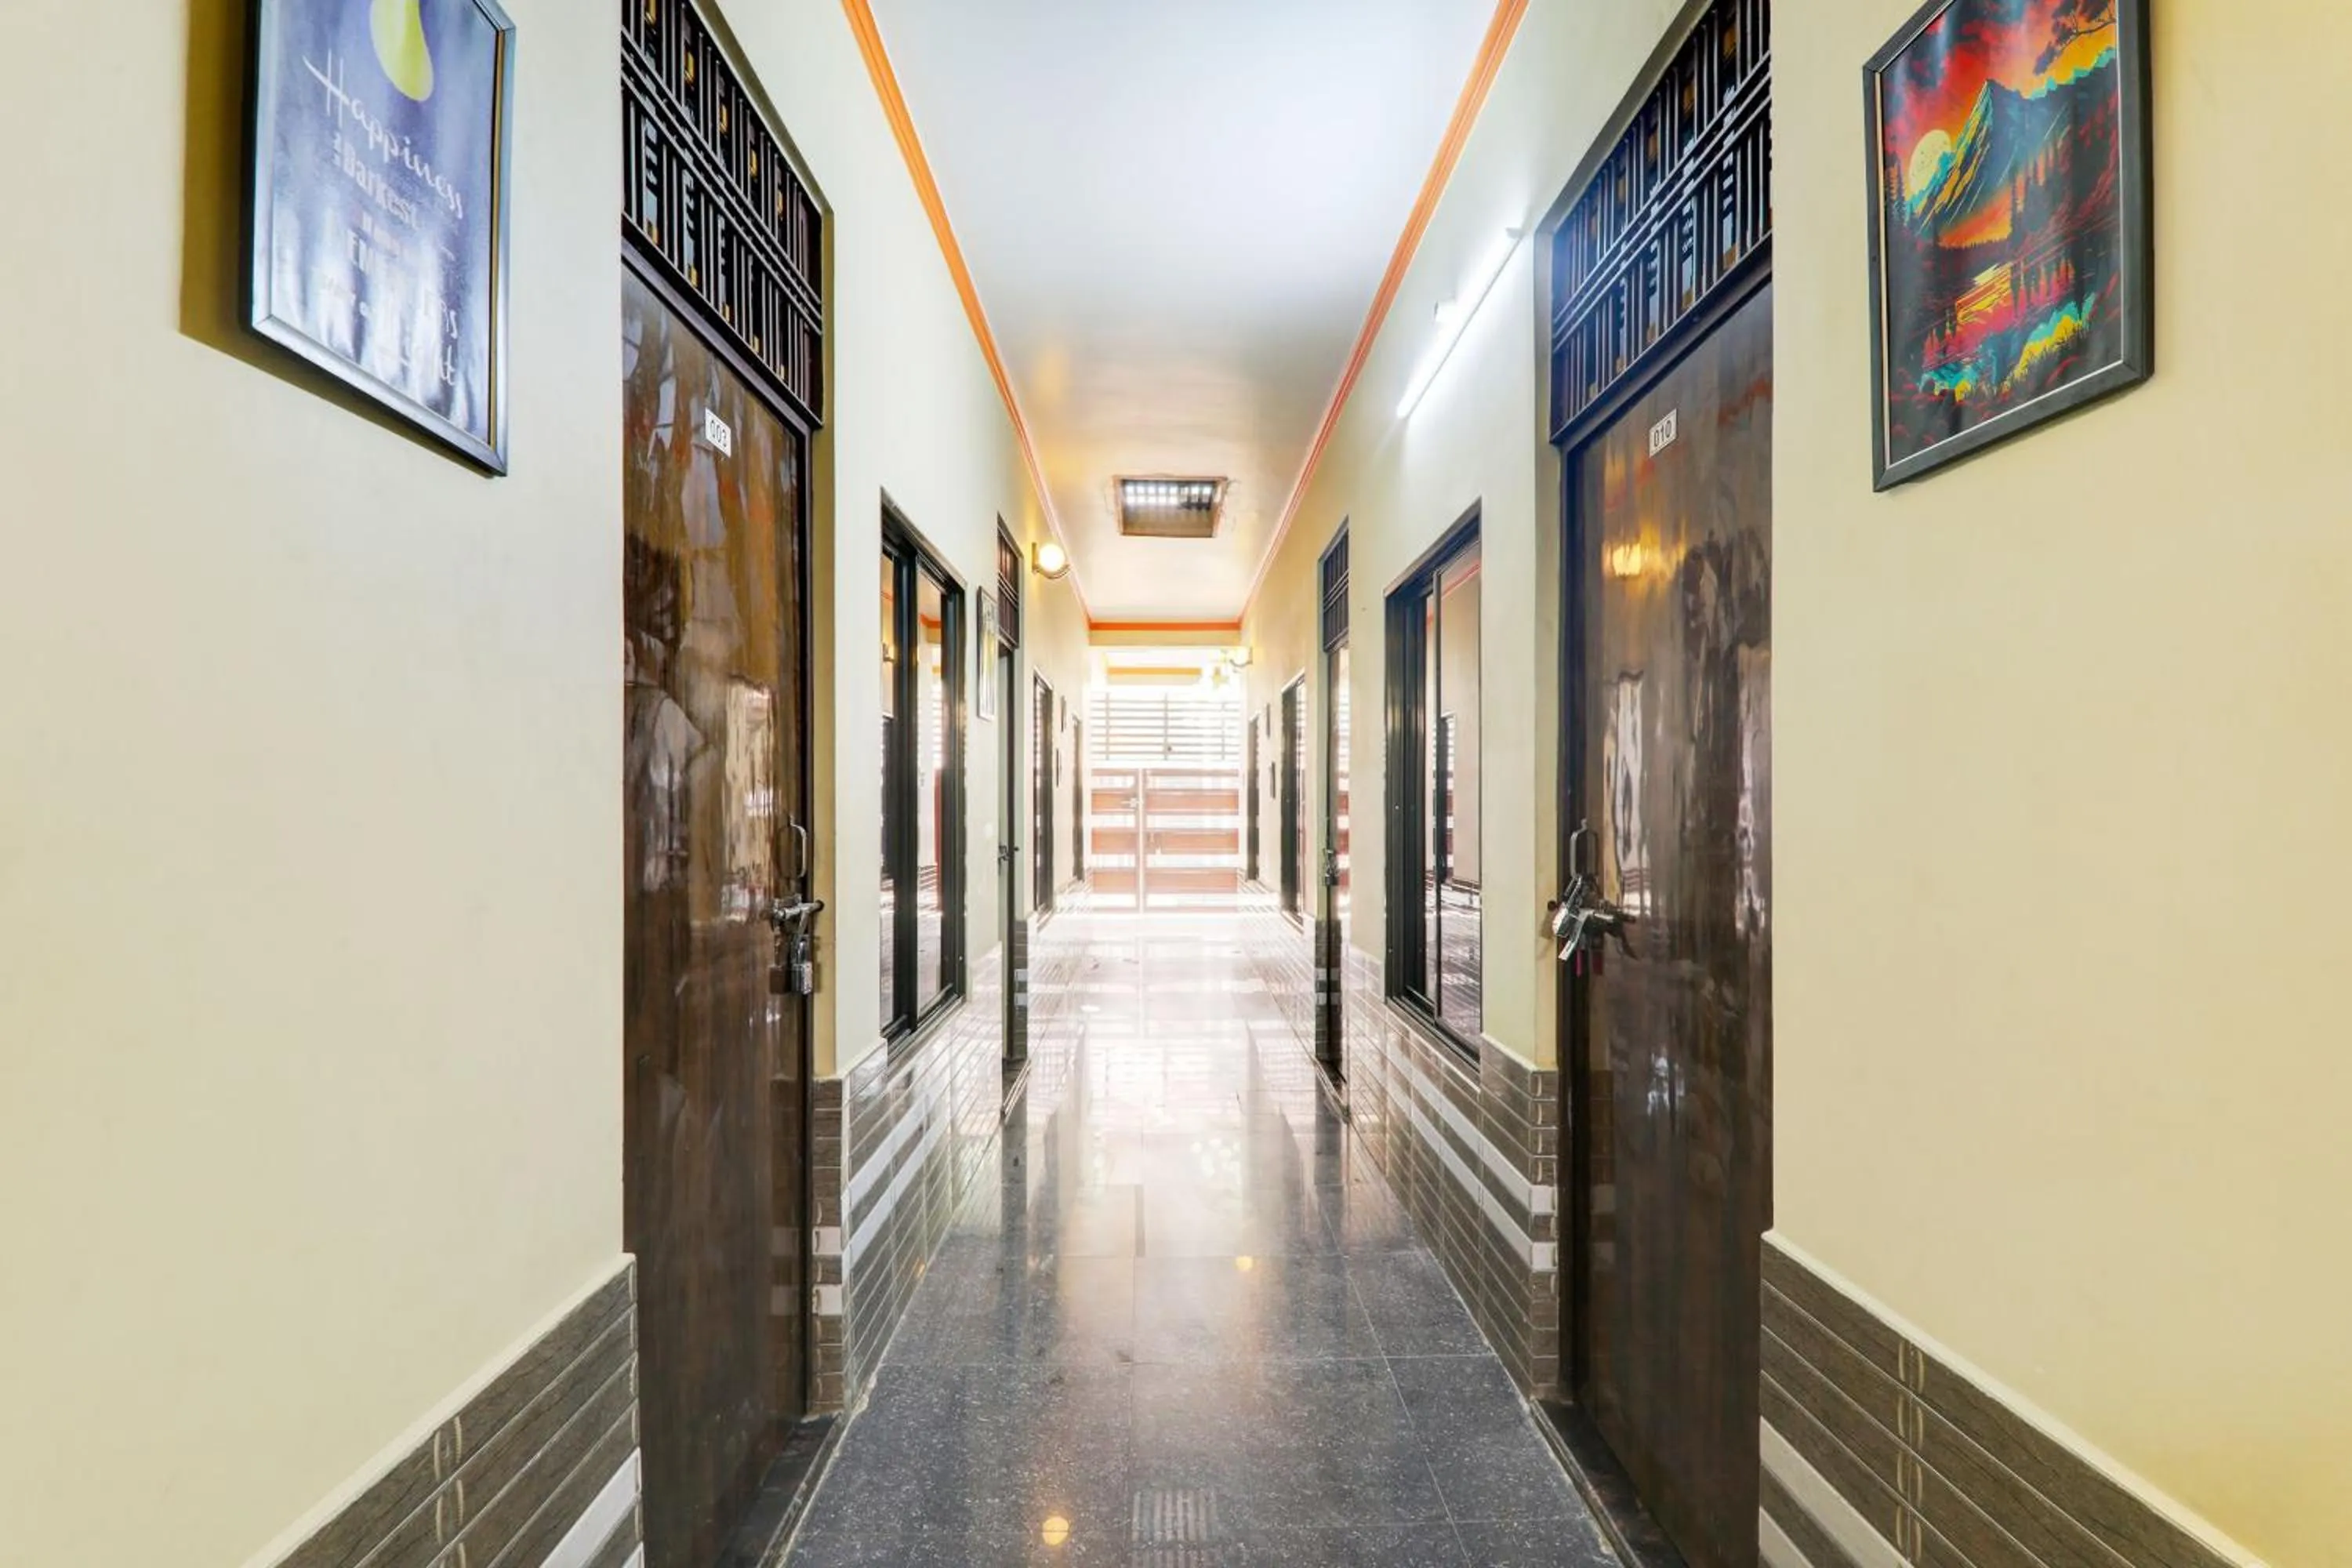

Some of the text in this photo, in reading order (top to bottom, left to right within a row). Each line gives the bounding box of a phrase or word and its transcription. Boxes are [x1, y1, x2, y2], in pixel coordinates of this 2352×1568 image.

[303, 49, 463, 219] Happiness
[343, 141, 421, 230] Darkest
[710, 419, 727, 448] 003
[1653, 419, 1672, 447] 010
